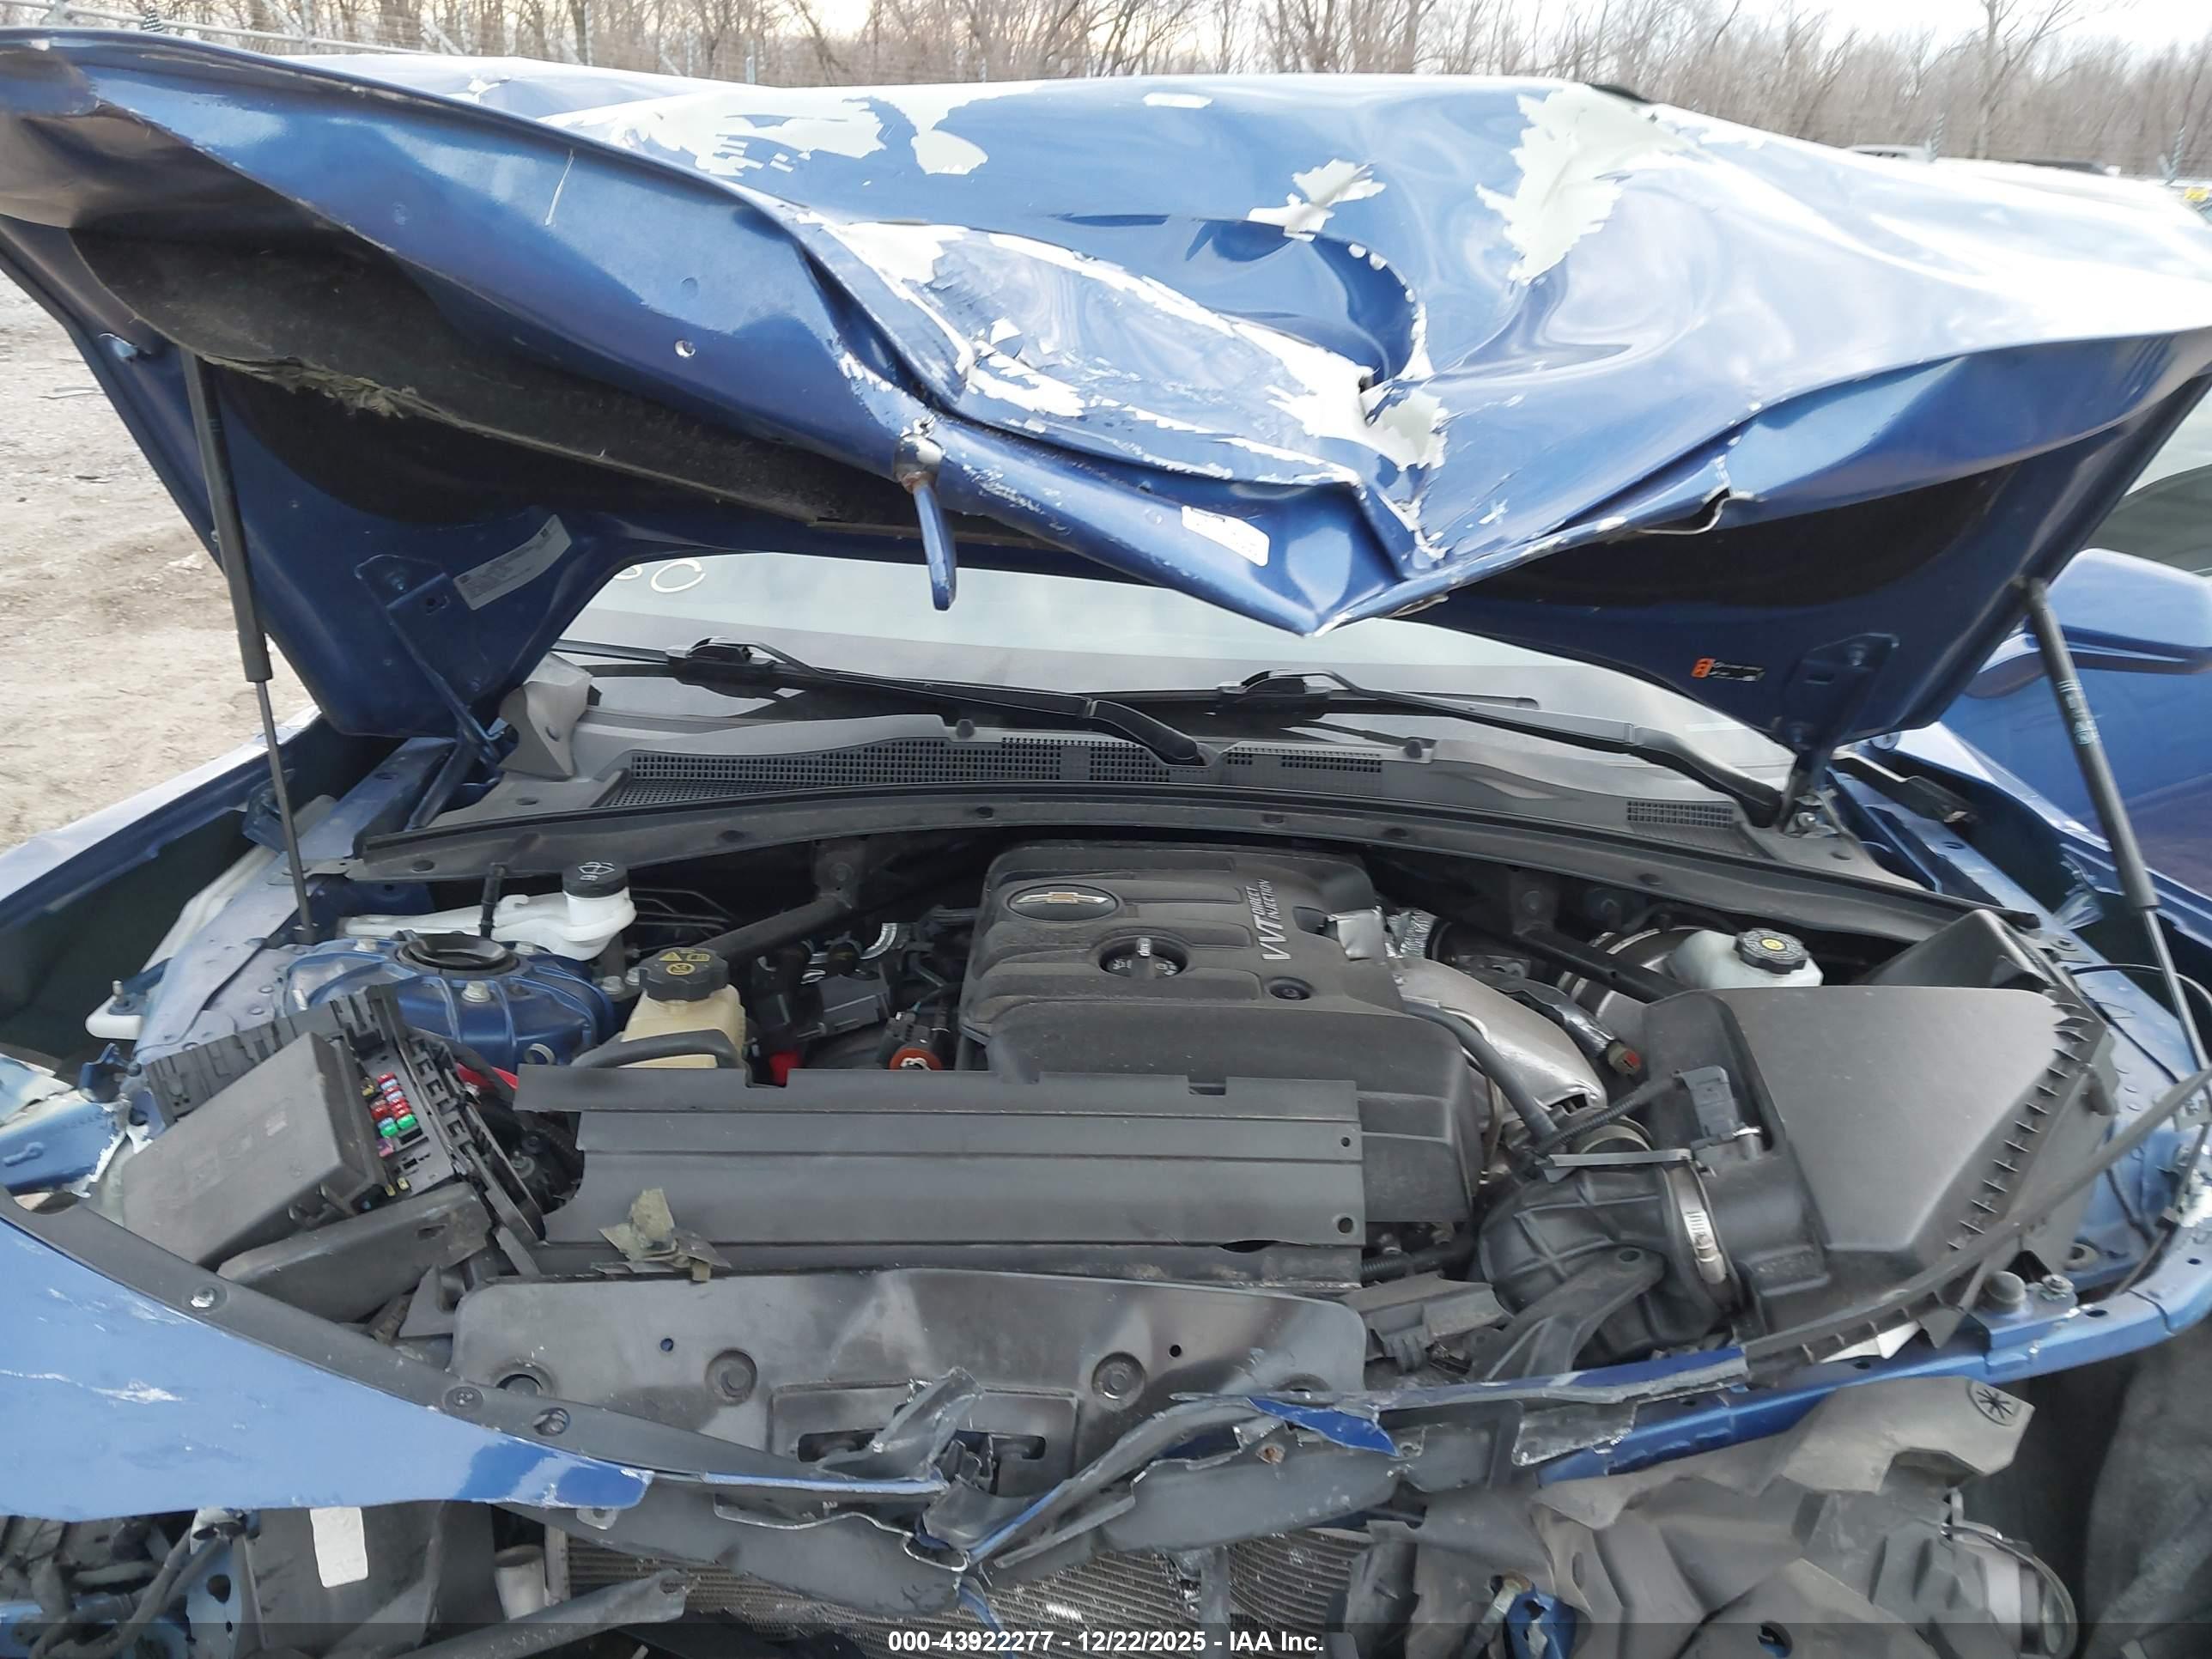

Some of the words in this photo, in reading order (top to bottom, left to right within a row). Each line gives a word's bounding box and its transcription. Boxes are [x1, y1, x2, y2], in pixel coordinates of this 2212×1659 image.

[1245, 885, 1266, 916] DIRECT
[1256, 878, 1282, 921] INJECTION
[1253, 914, 1291, 959] VVT
